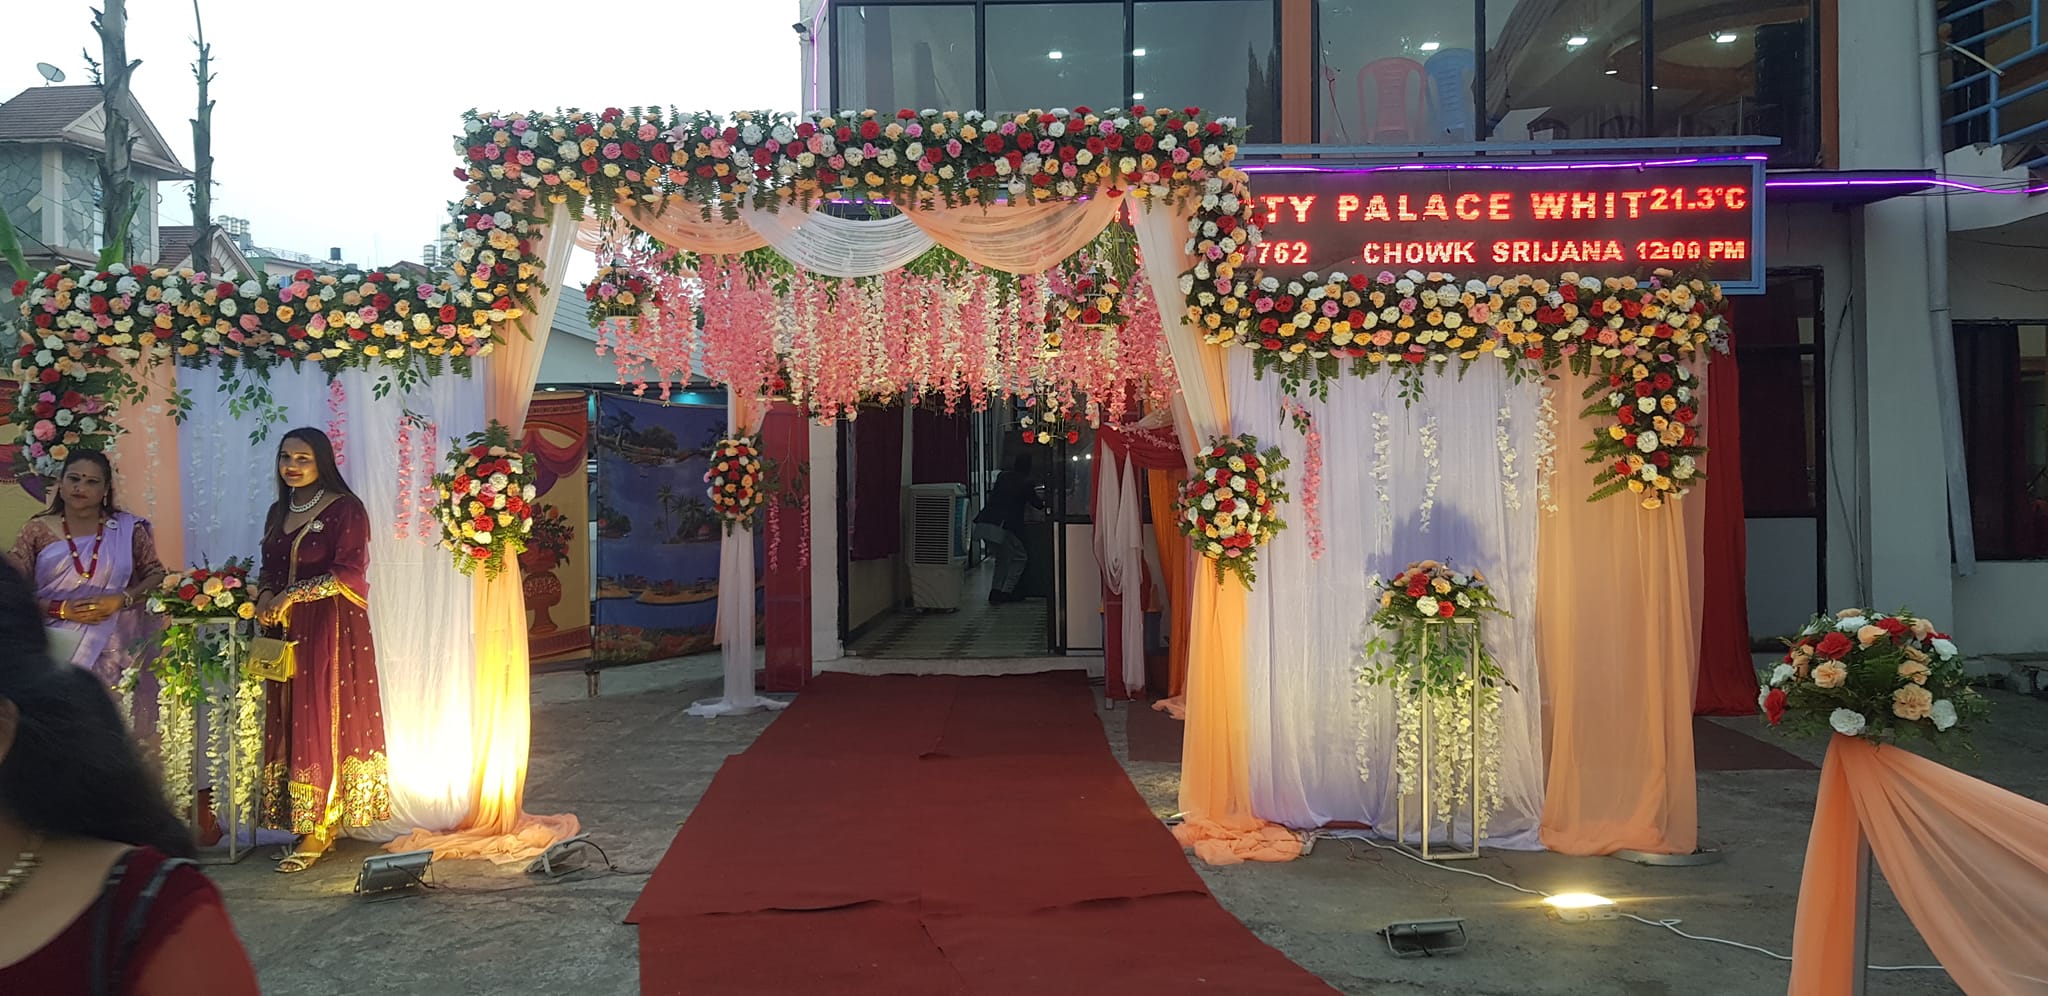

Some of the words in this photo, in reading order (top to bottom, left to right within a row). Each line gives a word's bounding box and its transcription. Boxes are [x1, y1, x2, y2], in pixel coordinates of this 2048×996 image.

[1243, 194, 1316, 223] TY
[1337, 192, 1512, 222] PALACE
[1530, 191, 1647, 220] WHIT
[1649, 186, 1747, 211] 21.3°C
[1246, 240, 1308, 264] 762
[1363, 240, 1476, 265] CHOWK
[1491, 239, 1625, 263] SRIJANA
[1636, 240, 1701, 261] 12:00
[1708, 240, 1746, 260] PM
